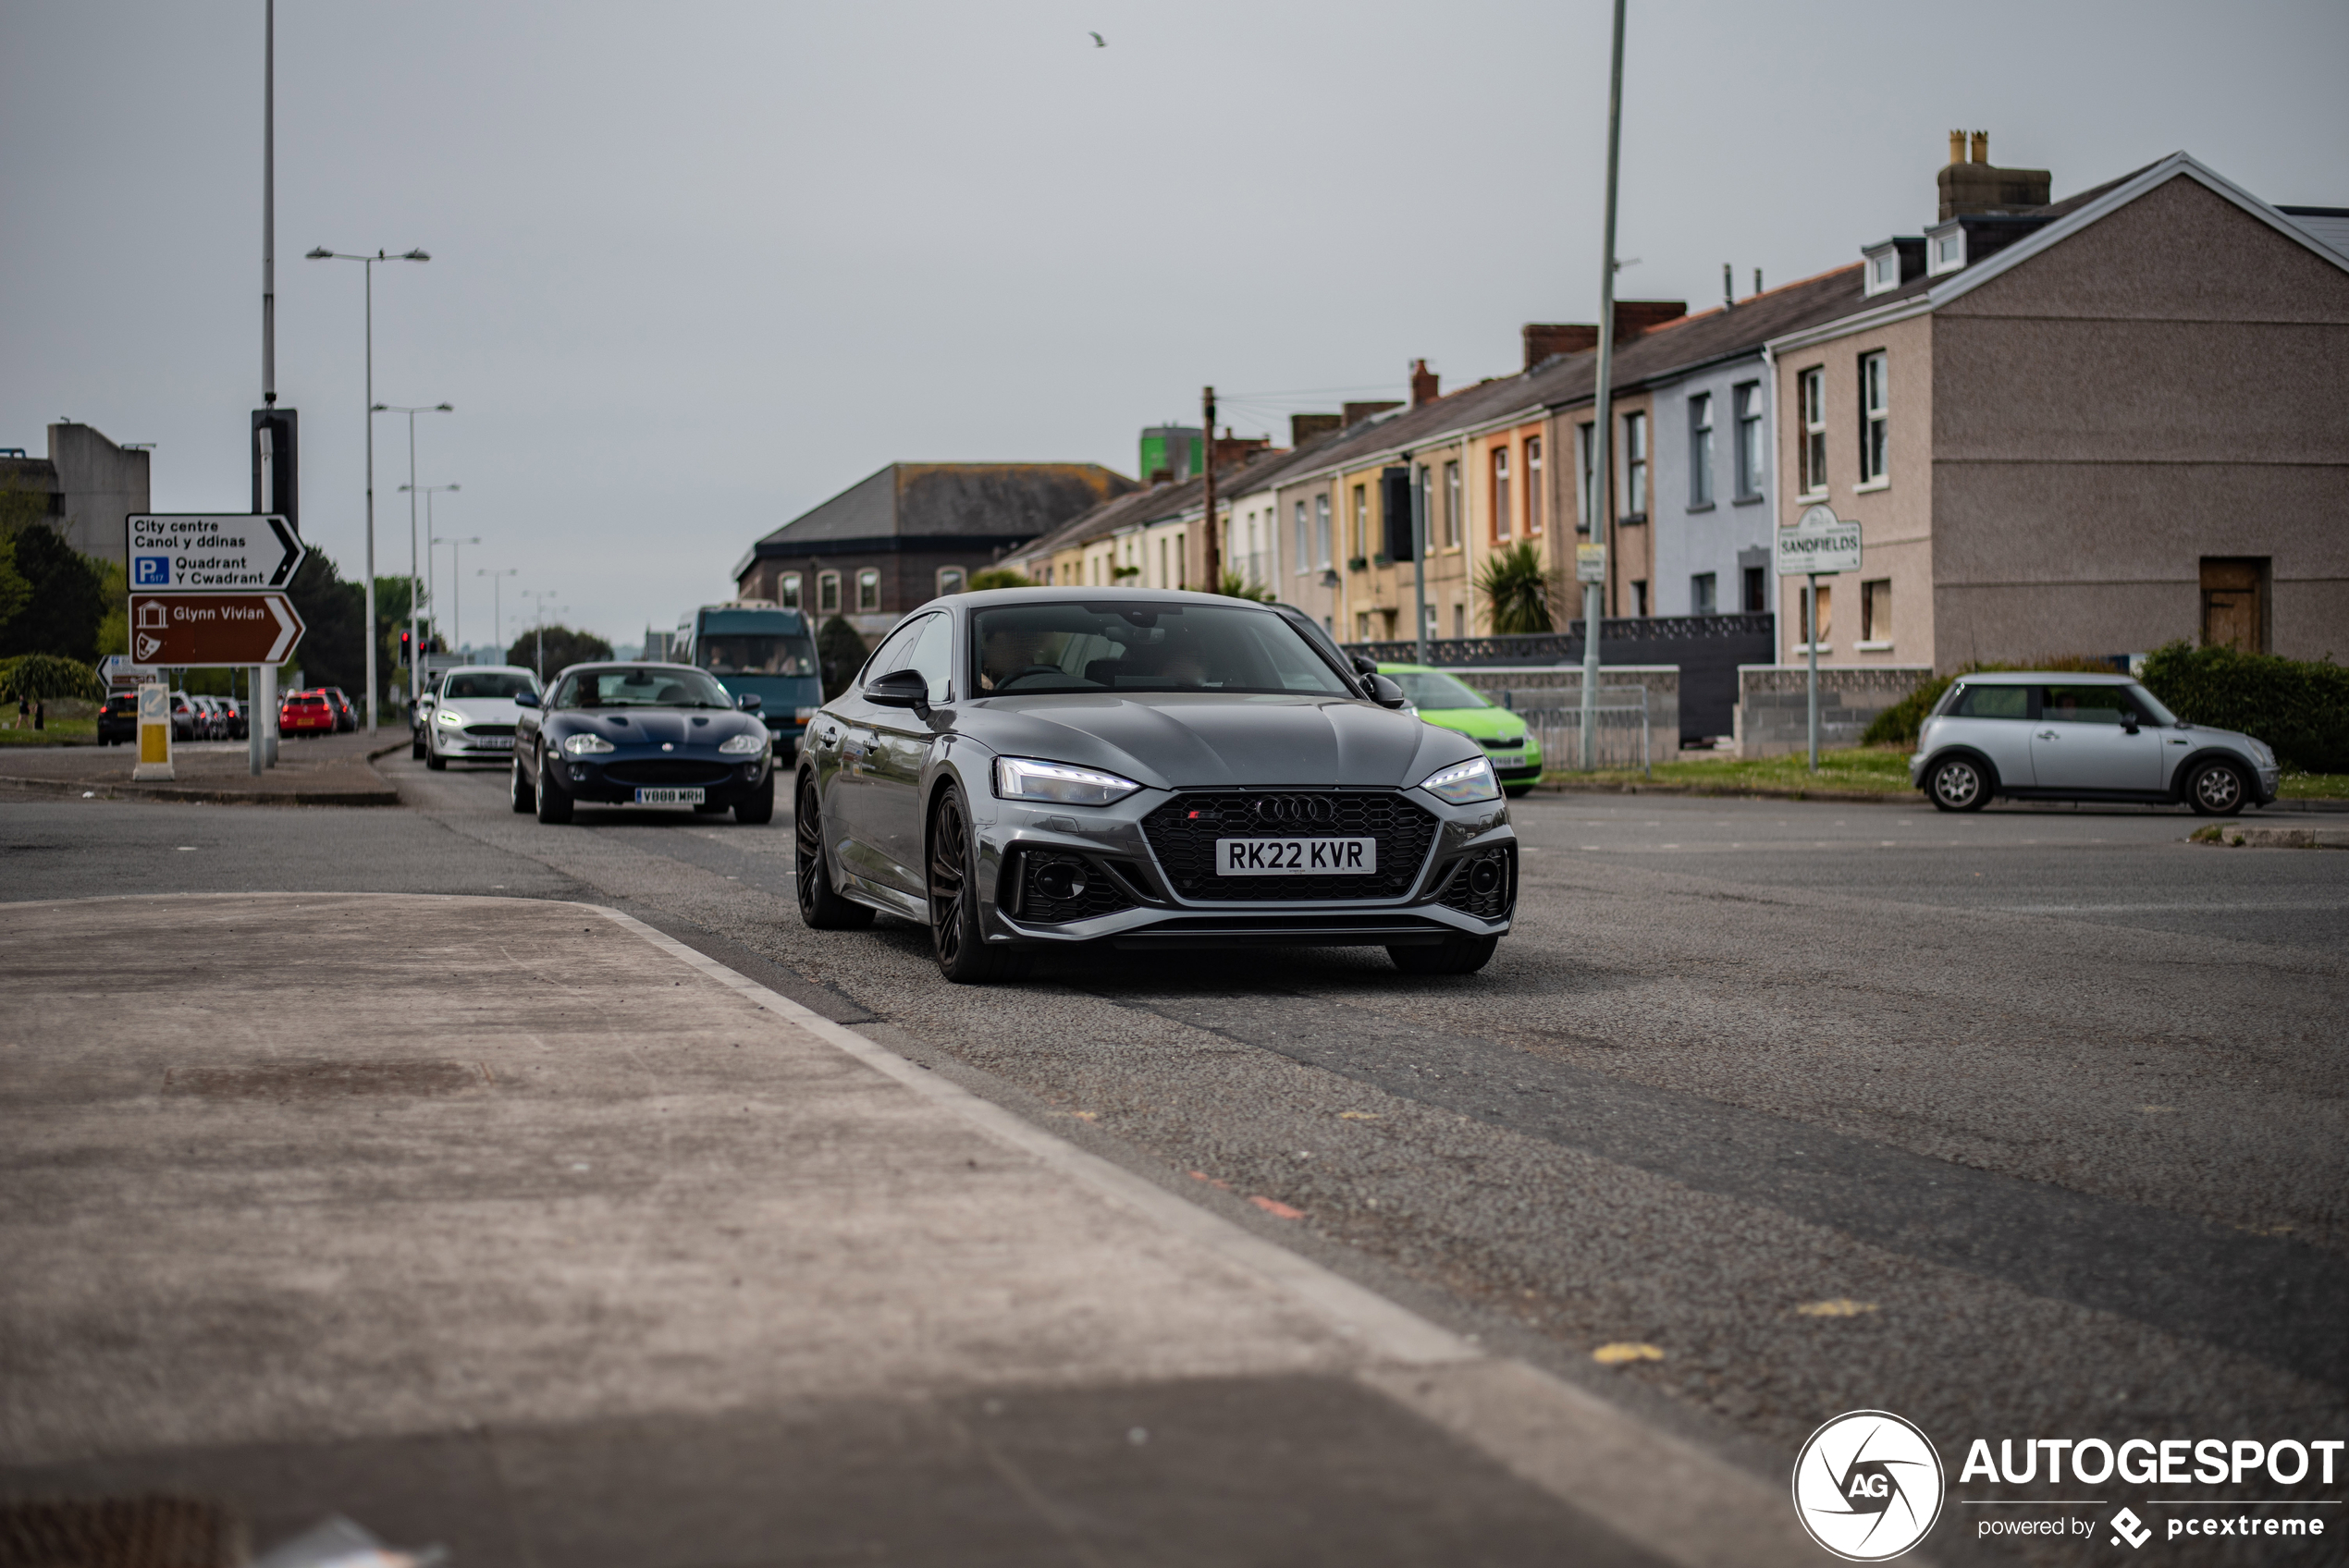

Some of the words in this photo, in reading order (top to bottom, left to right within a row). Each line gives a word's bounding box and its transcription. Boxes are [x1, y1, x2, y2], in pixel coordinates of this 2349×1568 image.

[134, 520, 165, 534] City
[170, 520, 218, 533] centre
[134, 534, 178, 548] Canol
[184, 538, 191, 550] y
[197, 534, 246, 548] ddinas
[1781, 535, 1858, 555] SANDFIELDS
[140, 559, 156, 582] P
[176, 557, 247, 570] Quadrant
[176, 571, 185, 584] Y
[191, 571, 264, 584] Cwadrant
[173, 606, 215, 622] Glynn
[221, 606, 264, 620] Vivian
[1229, 842, 1302, 869] RK22
[1310, 841, 1363, 868] KVR
